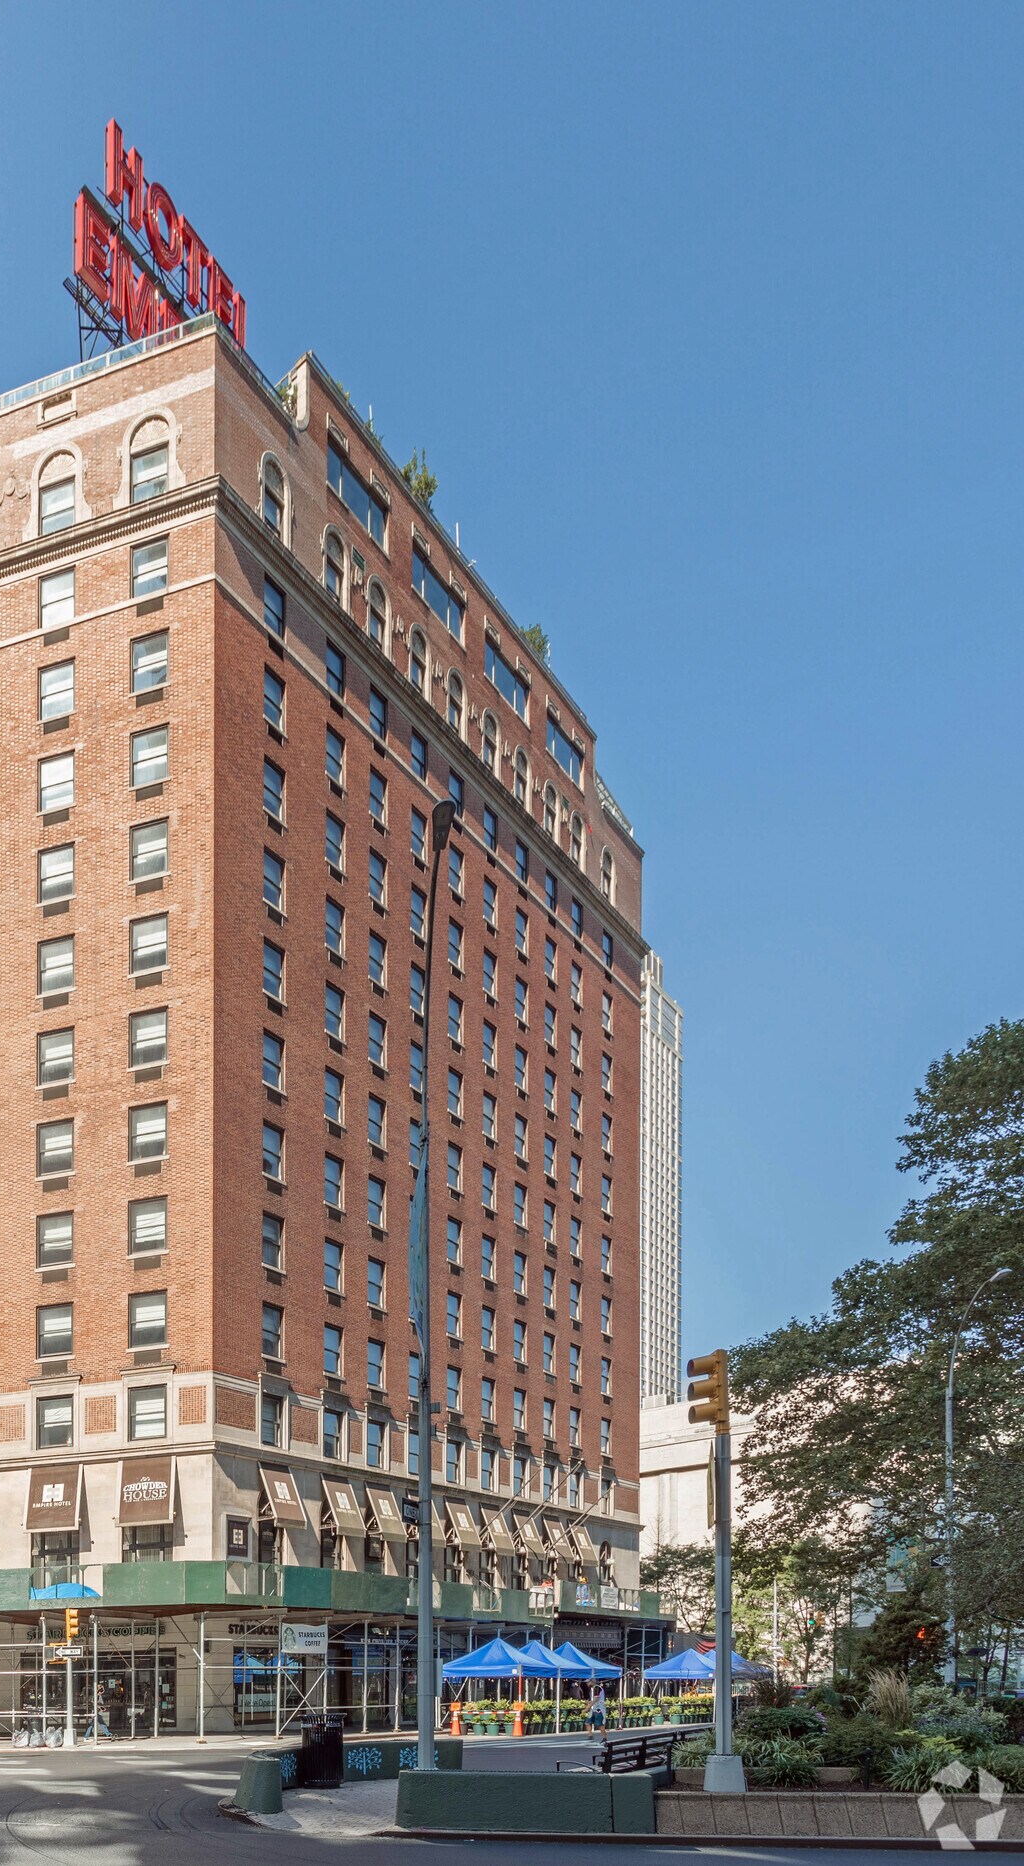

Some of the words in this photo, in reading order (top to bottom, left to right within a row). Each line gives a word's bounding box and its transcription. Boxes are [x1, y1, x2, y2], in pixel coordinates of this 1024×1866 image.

[123, 1481, 168, 1491] CHOWDER
[123, 1489, 167, 1500] HOUSE
[26, 1627, 111, 1640] STARUCKS
[228, 1623, 279, 1635] STARBUCKS
